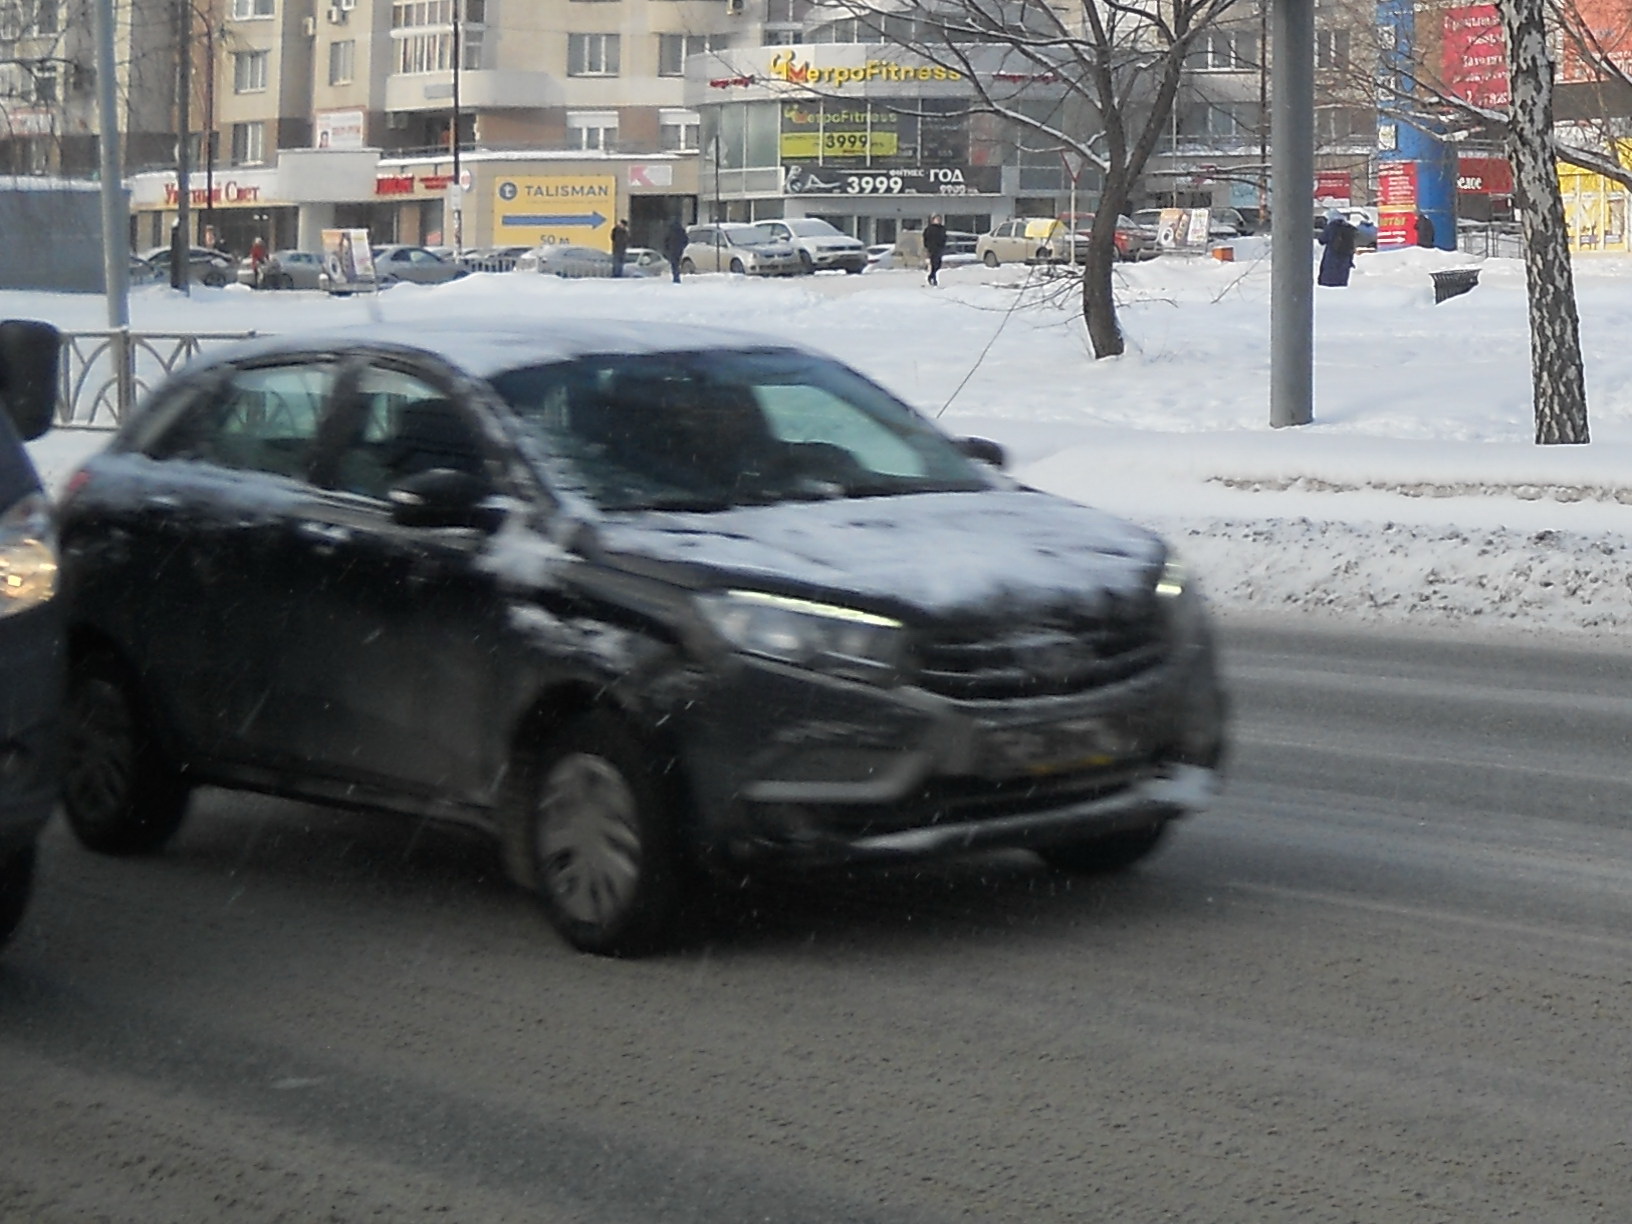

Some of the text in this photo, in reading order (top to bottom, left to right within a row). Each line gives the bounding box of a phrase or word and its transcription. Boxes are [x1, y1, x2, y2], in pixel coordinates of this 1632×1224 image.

[825, 134, 869, 149] 3999
[930, 169, 964, 182] ГОД
[846, 176, 903, 194] 3999
[1456, 177, 1482, 190] елое
[525, 185, 609, 197] TALISMAN
[540, 234, 556, 244] 50
